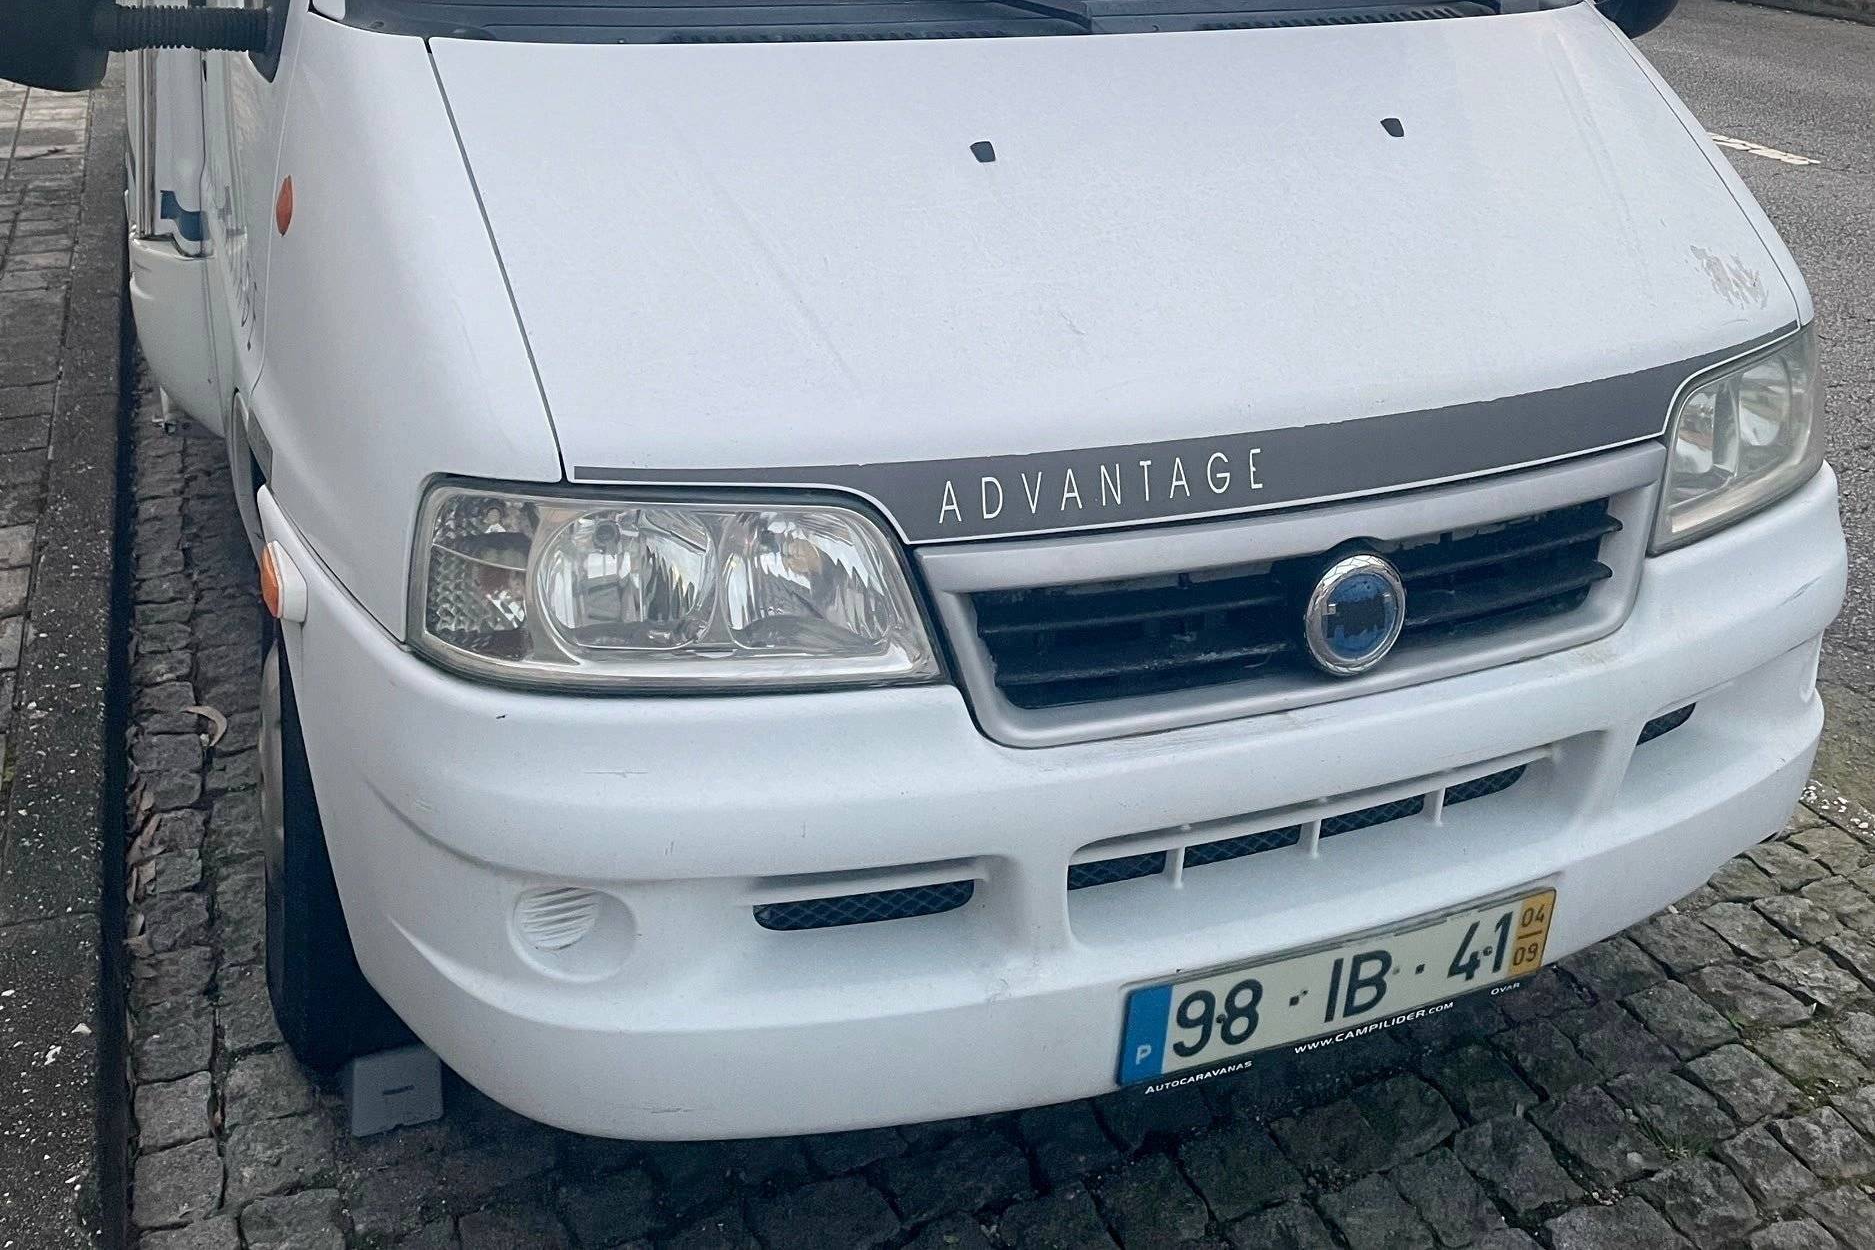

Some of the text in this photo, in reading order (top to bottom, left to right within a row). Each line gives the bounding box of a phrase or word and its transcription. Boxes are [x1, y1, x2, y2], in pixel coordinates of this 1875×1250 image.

[939, 448, 1262, 524] ADVANTAGE
[1521, 904, 1545, 928] 04
[1512, 942, 1538, 967] 09
[1135, 1044, 1152, 1066] P
